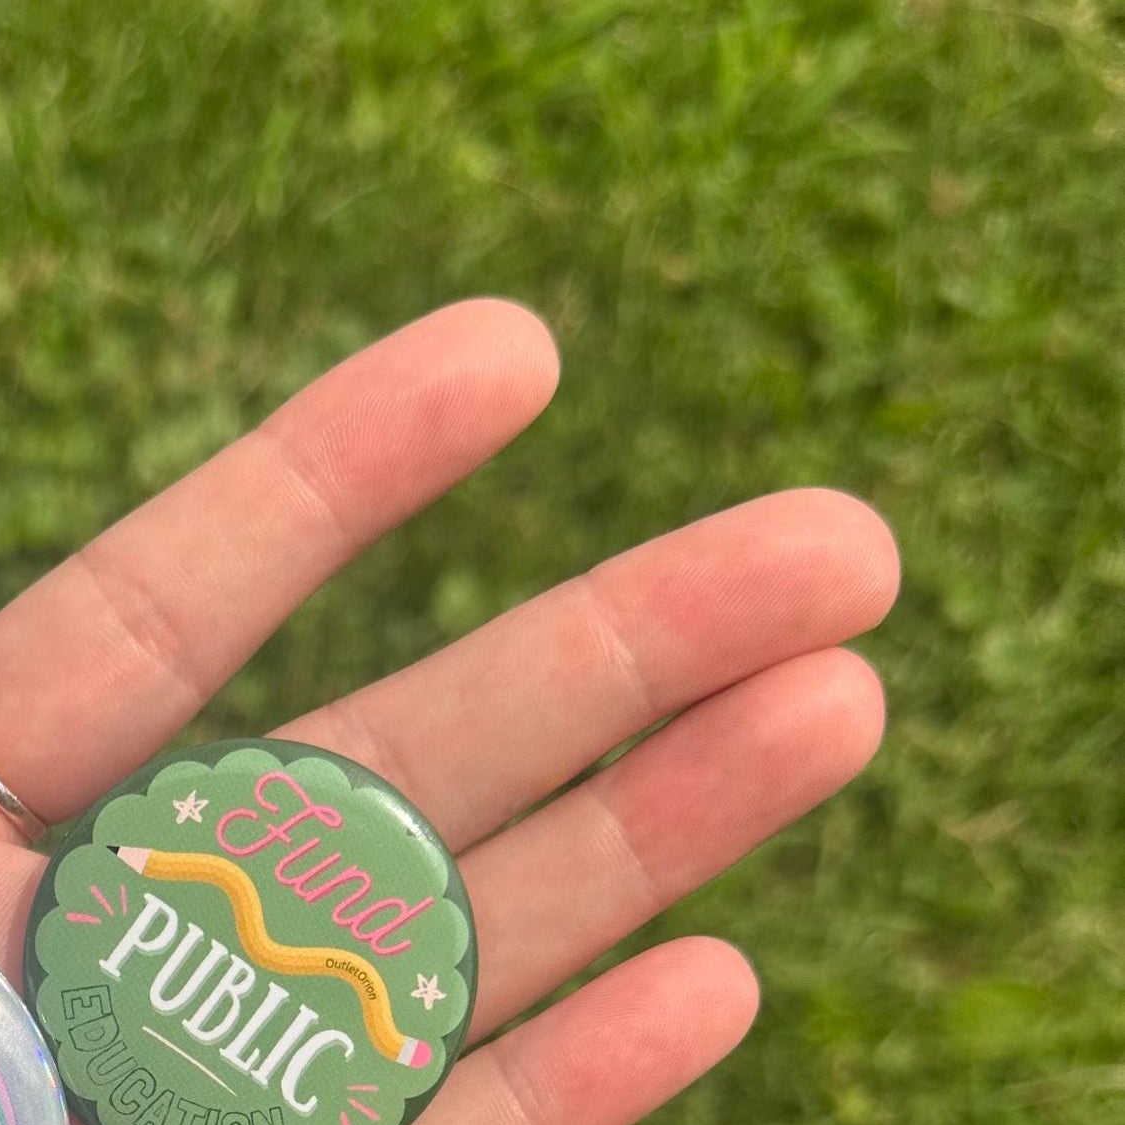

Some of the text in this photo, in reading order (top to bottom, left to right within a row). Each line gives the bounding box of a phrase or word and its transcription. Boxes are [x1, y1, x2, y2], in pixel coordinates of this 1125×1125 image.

[216, 771, 434, 957] Fund
[99, 893, 355, 1116] PUBLIC
[325, 958, 377, 1000] OutletOrion
